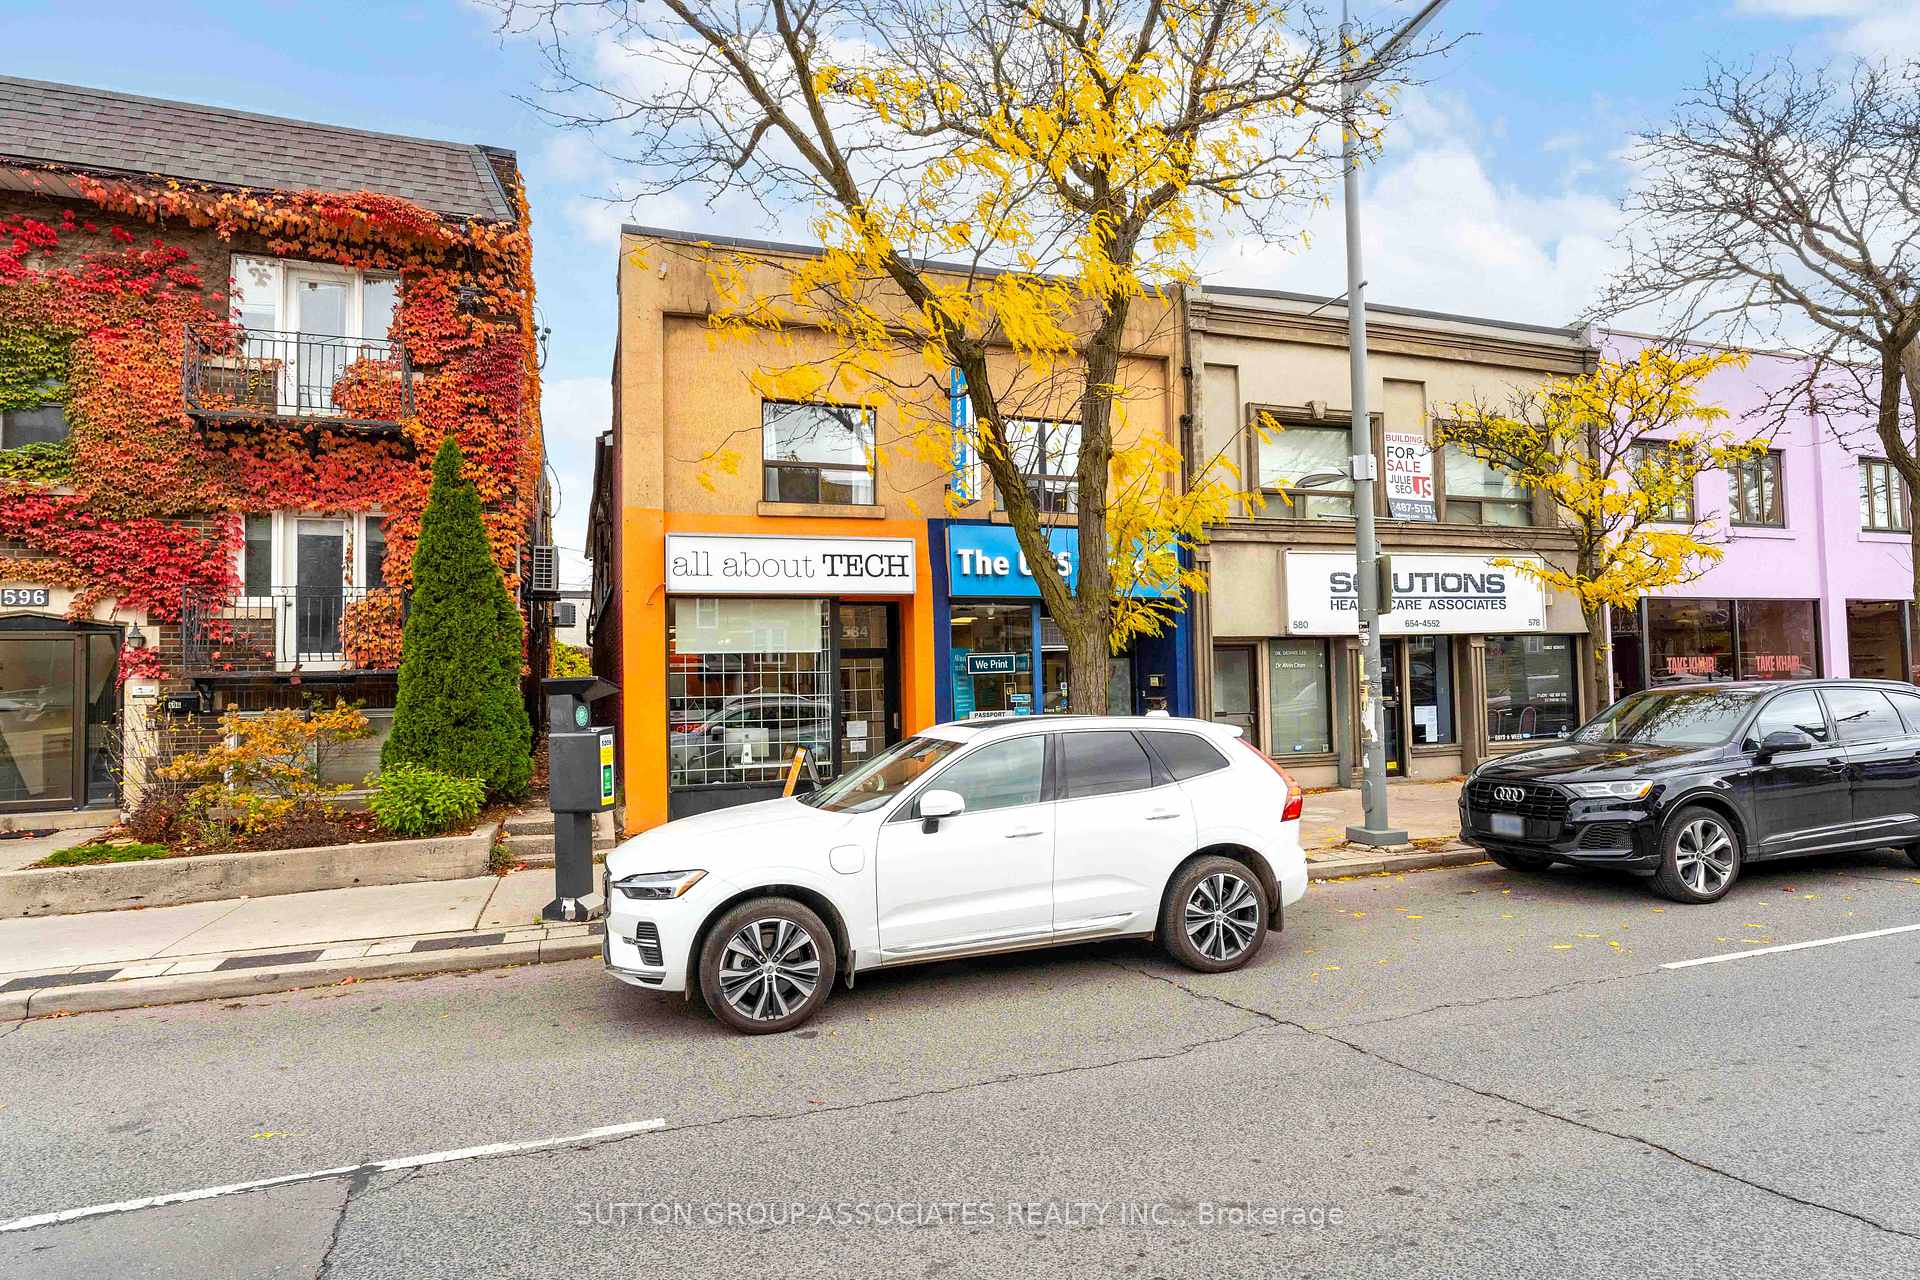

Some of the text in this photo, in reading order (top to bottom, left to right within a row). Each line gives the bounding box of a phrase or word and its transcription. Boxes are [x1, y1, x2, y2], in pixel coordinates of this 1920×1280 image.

[1385, 434, 1423, 444] BUILDING
[1386, 446, 1414, 459] FOR
[1387, 460, 1421, 473] SALE
[1389, 474, 1411, 484] JULIE
[1395, 485, 1412, 494] SEO
[672, 551, 910, 578] all about TECH
[957, 549, 1074, 578] The US
[1329, 571, 1505, 593] SUTIONS
[4, 589, 45, 605] 596
[1428, 599, 1507, 610] ASSOCIATES
[1292, 620, 1309, 629] 580
[1404, 619, 1441, 628] 654-4552
[1528, 618, 1541, 627] 578
[975, 660, 989, 670] We
[990, 659, 1008, 669] Print
[1666, 656, 1688, 674] TAKE
[1755, 655, 1776, 672] TAKE
